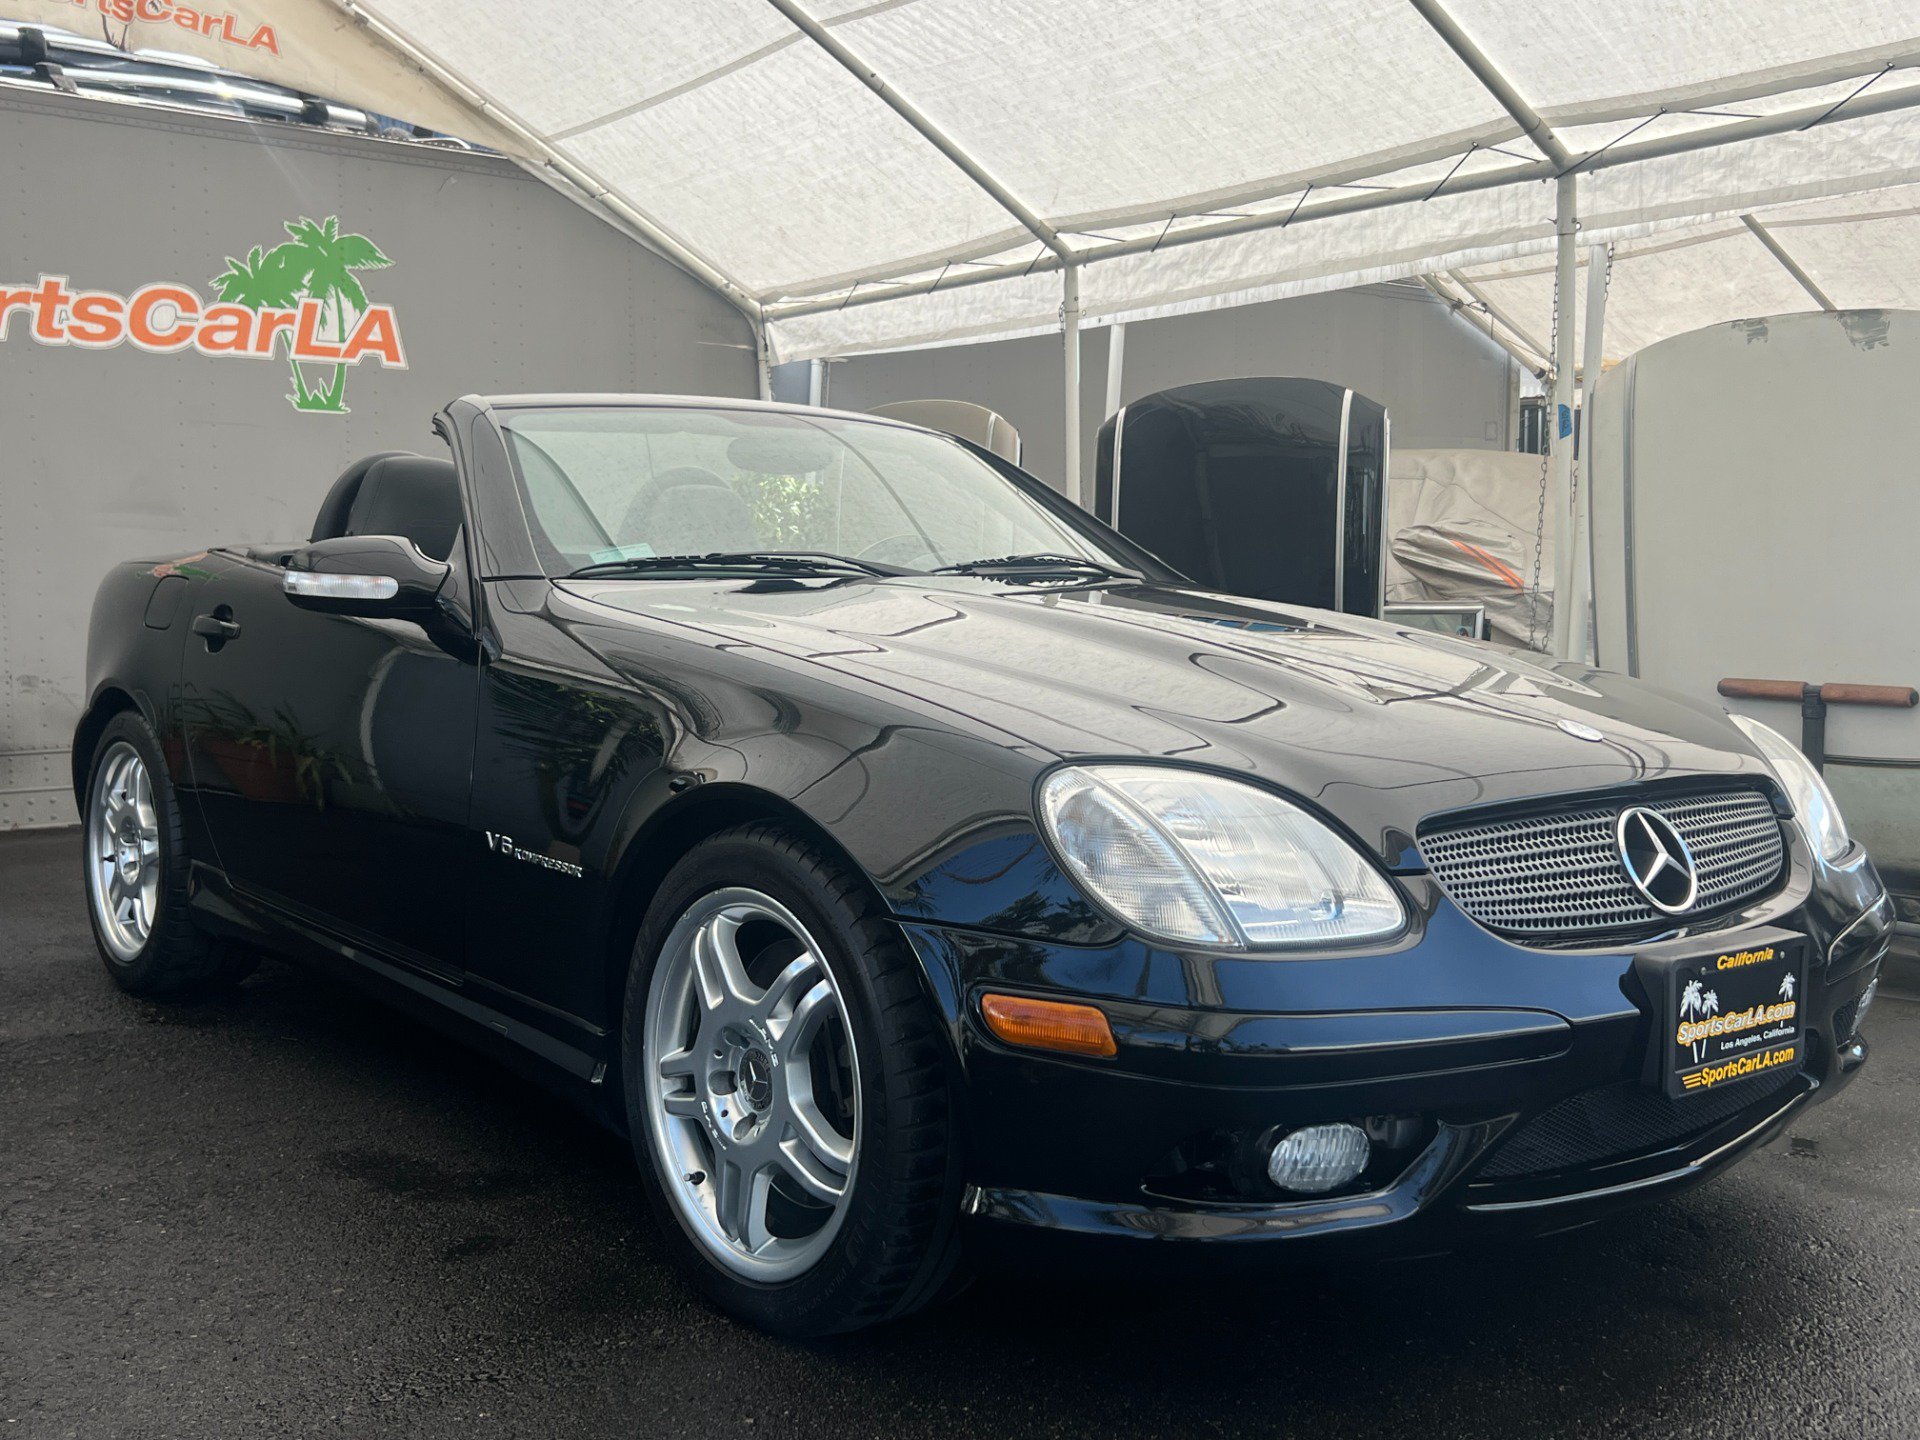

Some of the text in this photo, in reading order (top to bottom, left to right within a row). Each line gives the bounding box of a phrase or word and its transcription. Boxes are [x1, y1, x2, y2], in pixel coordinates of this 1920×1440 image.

[76, 0, 281, 55] sCarLA
[0, 278, 404, 366] rtsCarLA
[485, 830, 513, 855] V6
[1717, 948, 1774, 970] California
[1677, 1001, 1796, 1047] SportsCarLA.com
[1720, 1026, 1795, 1051] Los Angeles, California
[1701, 1047, 1795, 1088] SportsCarLA.com
